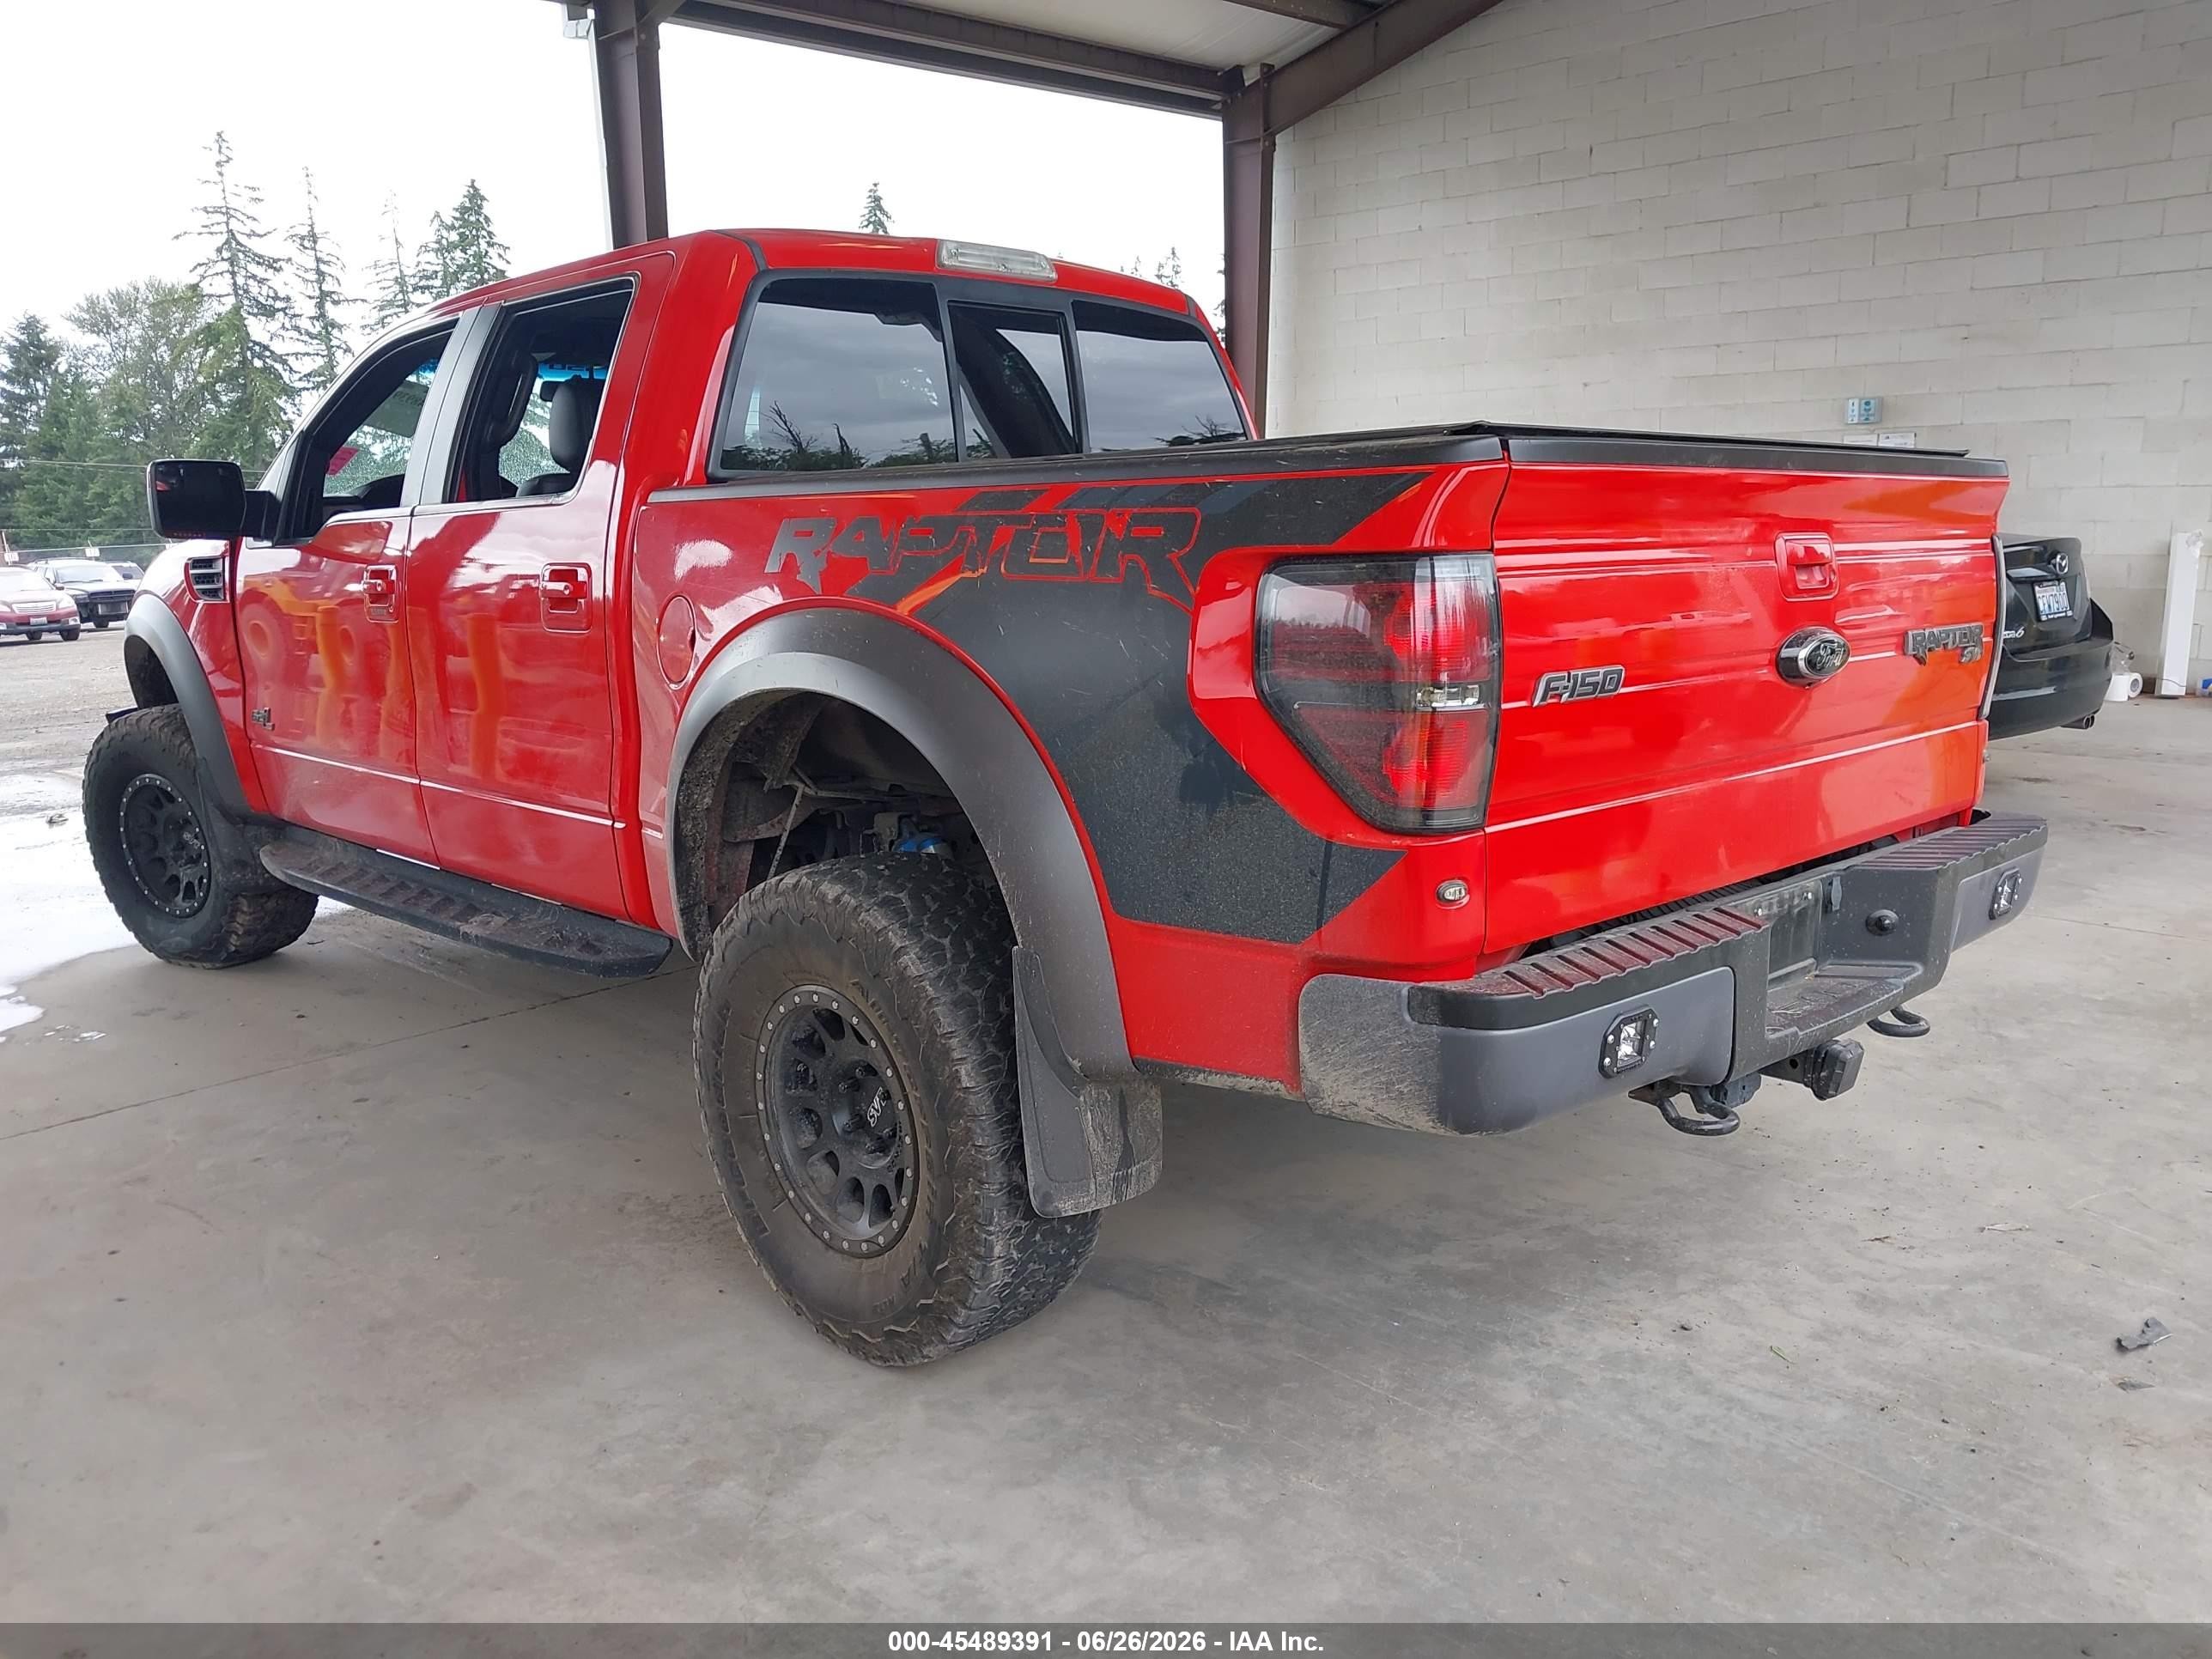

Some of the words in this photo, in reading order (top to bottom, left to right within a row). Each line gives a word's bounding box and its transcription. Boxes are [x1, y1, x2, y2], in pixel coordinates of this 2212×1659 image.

[763, 507, 1200, 616] RAPTOR
[1904, 622, 1984, 666] RAPTOR
[1533, 665, 1625, 708] F-150
